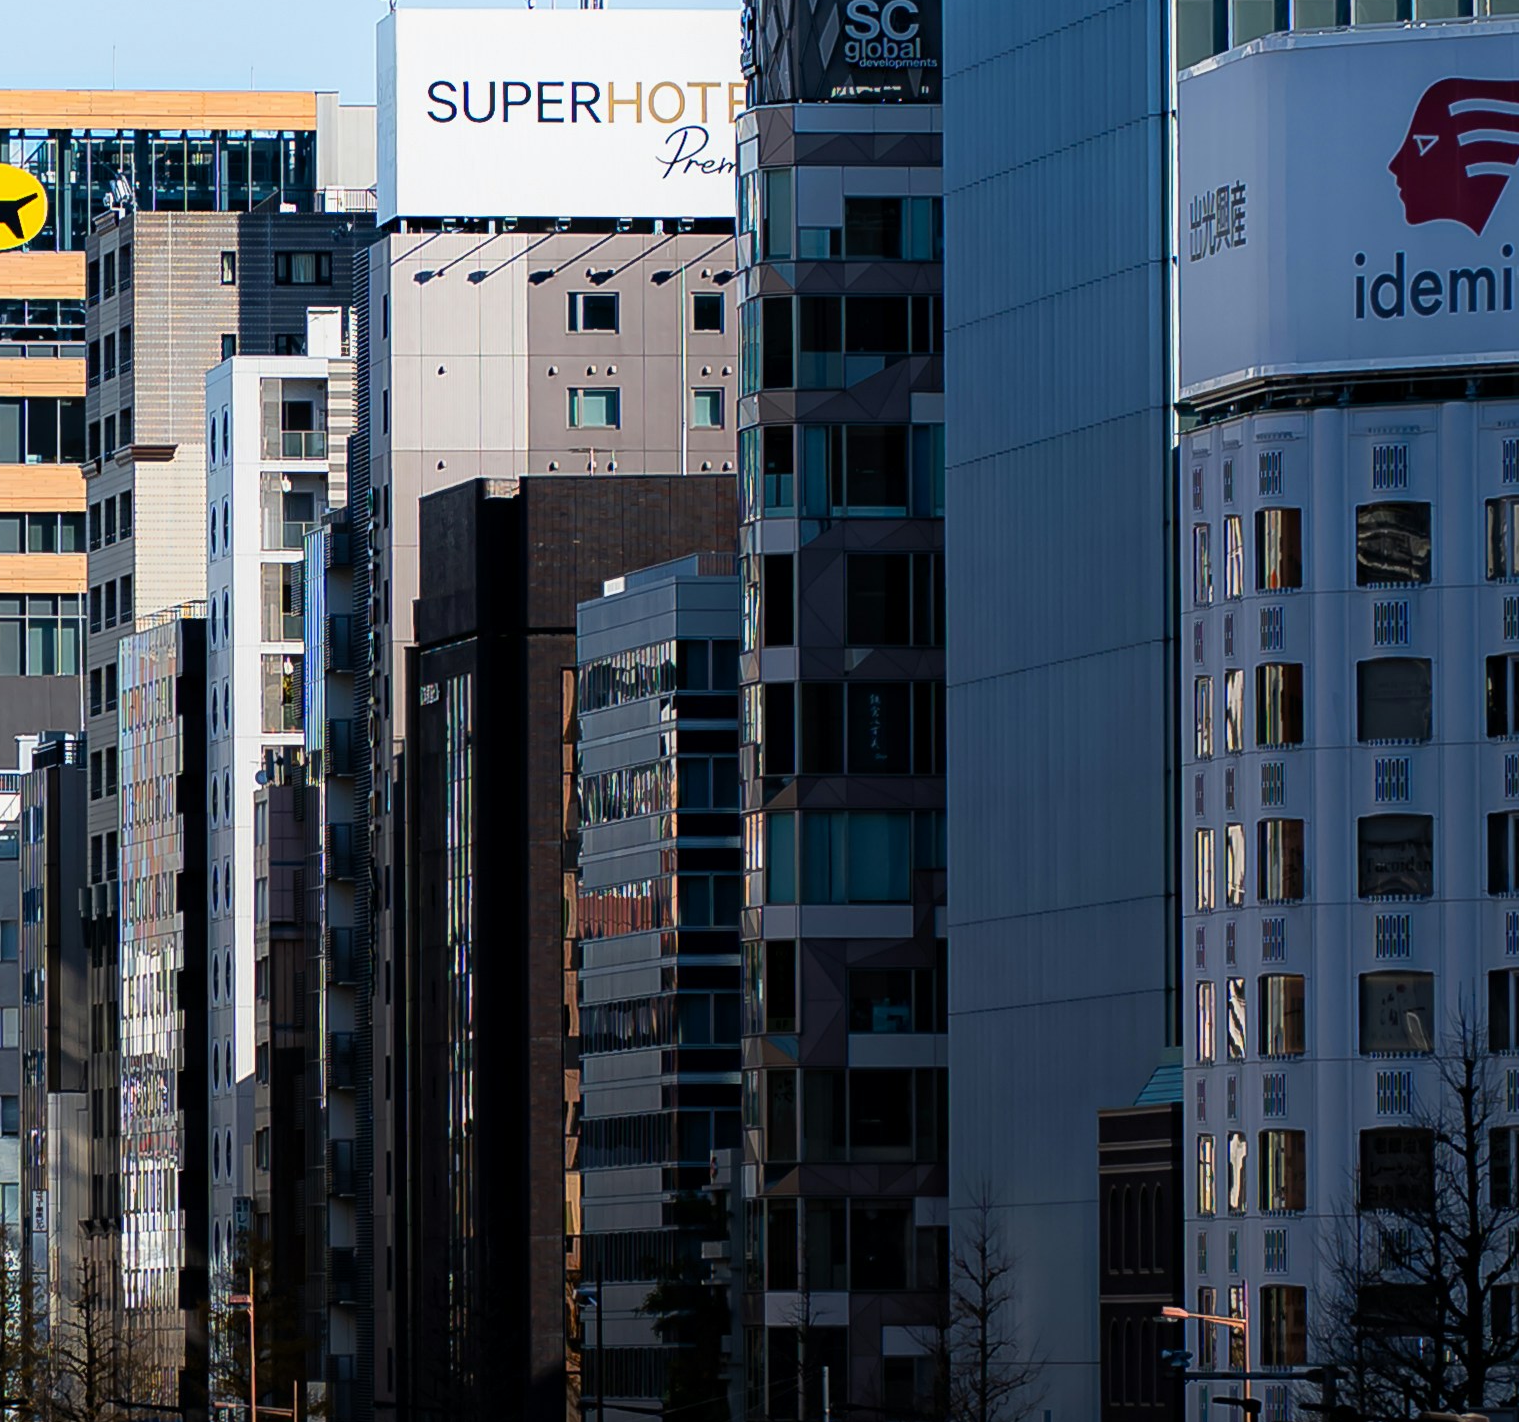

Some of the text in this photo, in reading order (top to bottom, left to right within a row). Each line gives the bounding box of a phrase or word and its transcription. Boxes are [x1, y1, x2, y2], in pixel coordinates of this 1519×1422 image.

[845, 37, 921, 63] global
[859, 59, 938, 69] developments
[1189, 180, 1247, 262] 出光興産
[1354, 244, 1514, 320] idemi
